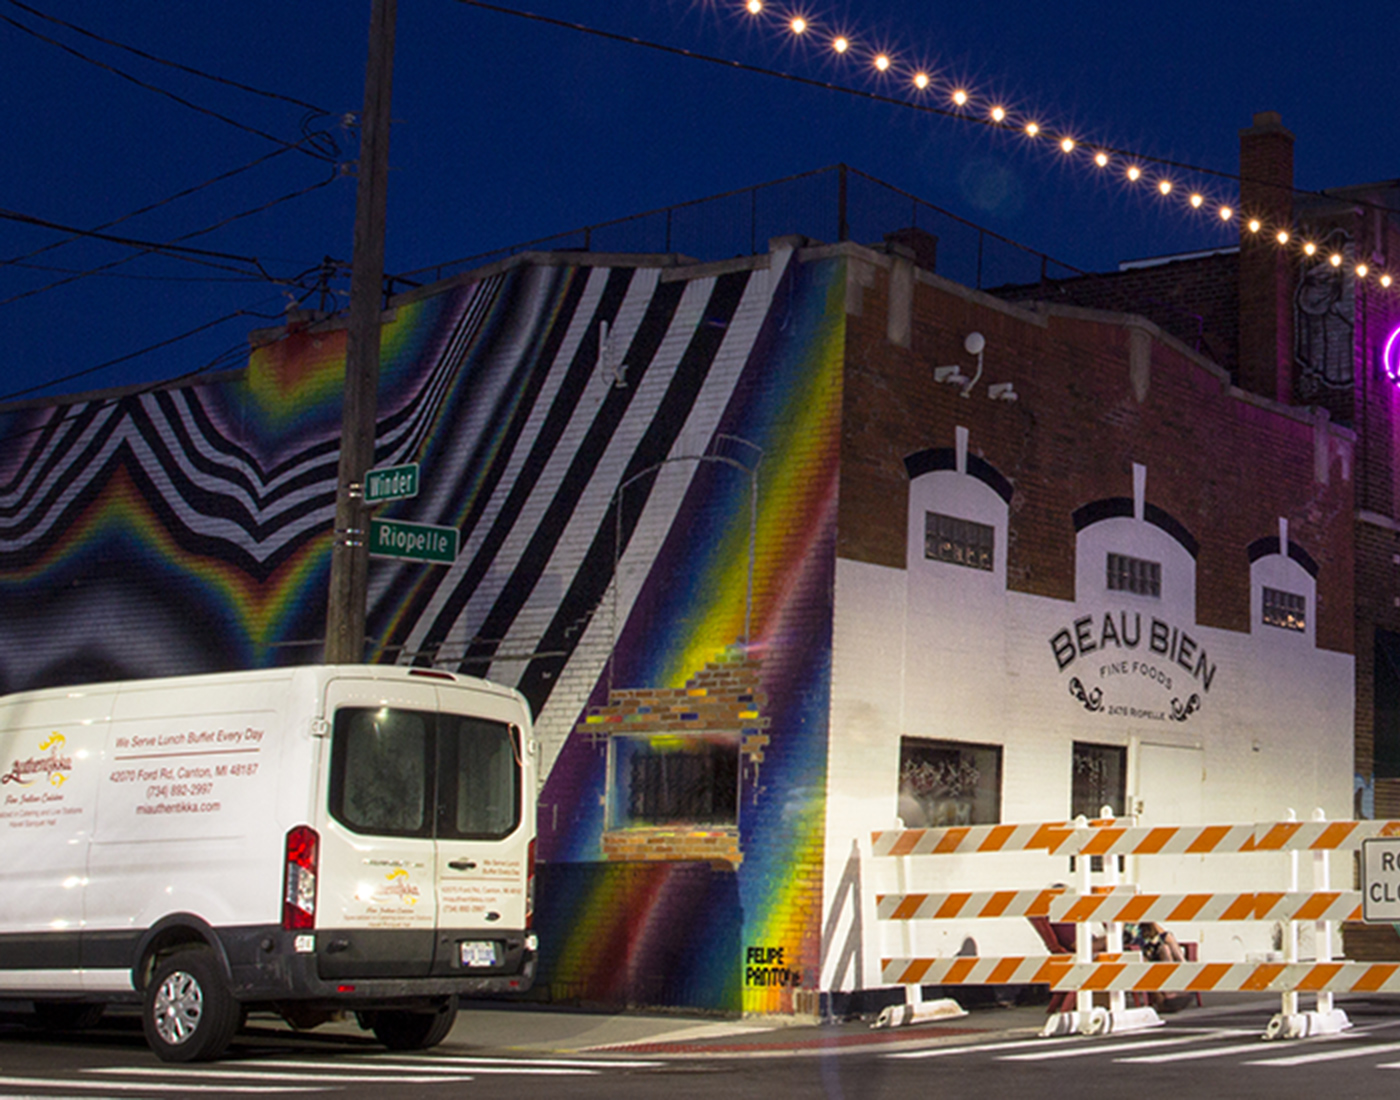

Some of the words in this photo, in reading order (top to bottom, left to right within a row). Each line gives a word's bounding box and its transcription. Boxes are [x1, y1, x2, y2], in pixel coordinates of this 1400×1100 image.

[369, 471, 413, 497] Winder
[379, 525, 448, 553] Riopelle
[1048, 610, 1142, 673] BEAU
[1148, 616, 1217, 693] BIEN
[1100, 661, 1129, 678] FINE
[1132, 661, 1173, 690] FOODS
[115, 737, 130, 748] We
[131, 735, 156, 748] Serve
[158, 733, 186, 746] Lunch
[187, 731, 215, 744] Buffet
[216, 729, 244, 743] Every
[245, 727, 264, 742] Day
[138, 769, 158, 781] Ford
[177, 766, 212, 779] Canton,
[215, 765, 228, 776] MI
[747, 946, 784, 965] FELIPE
